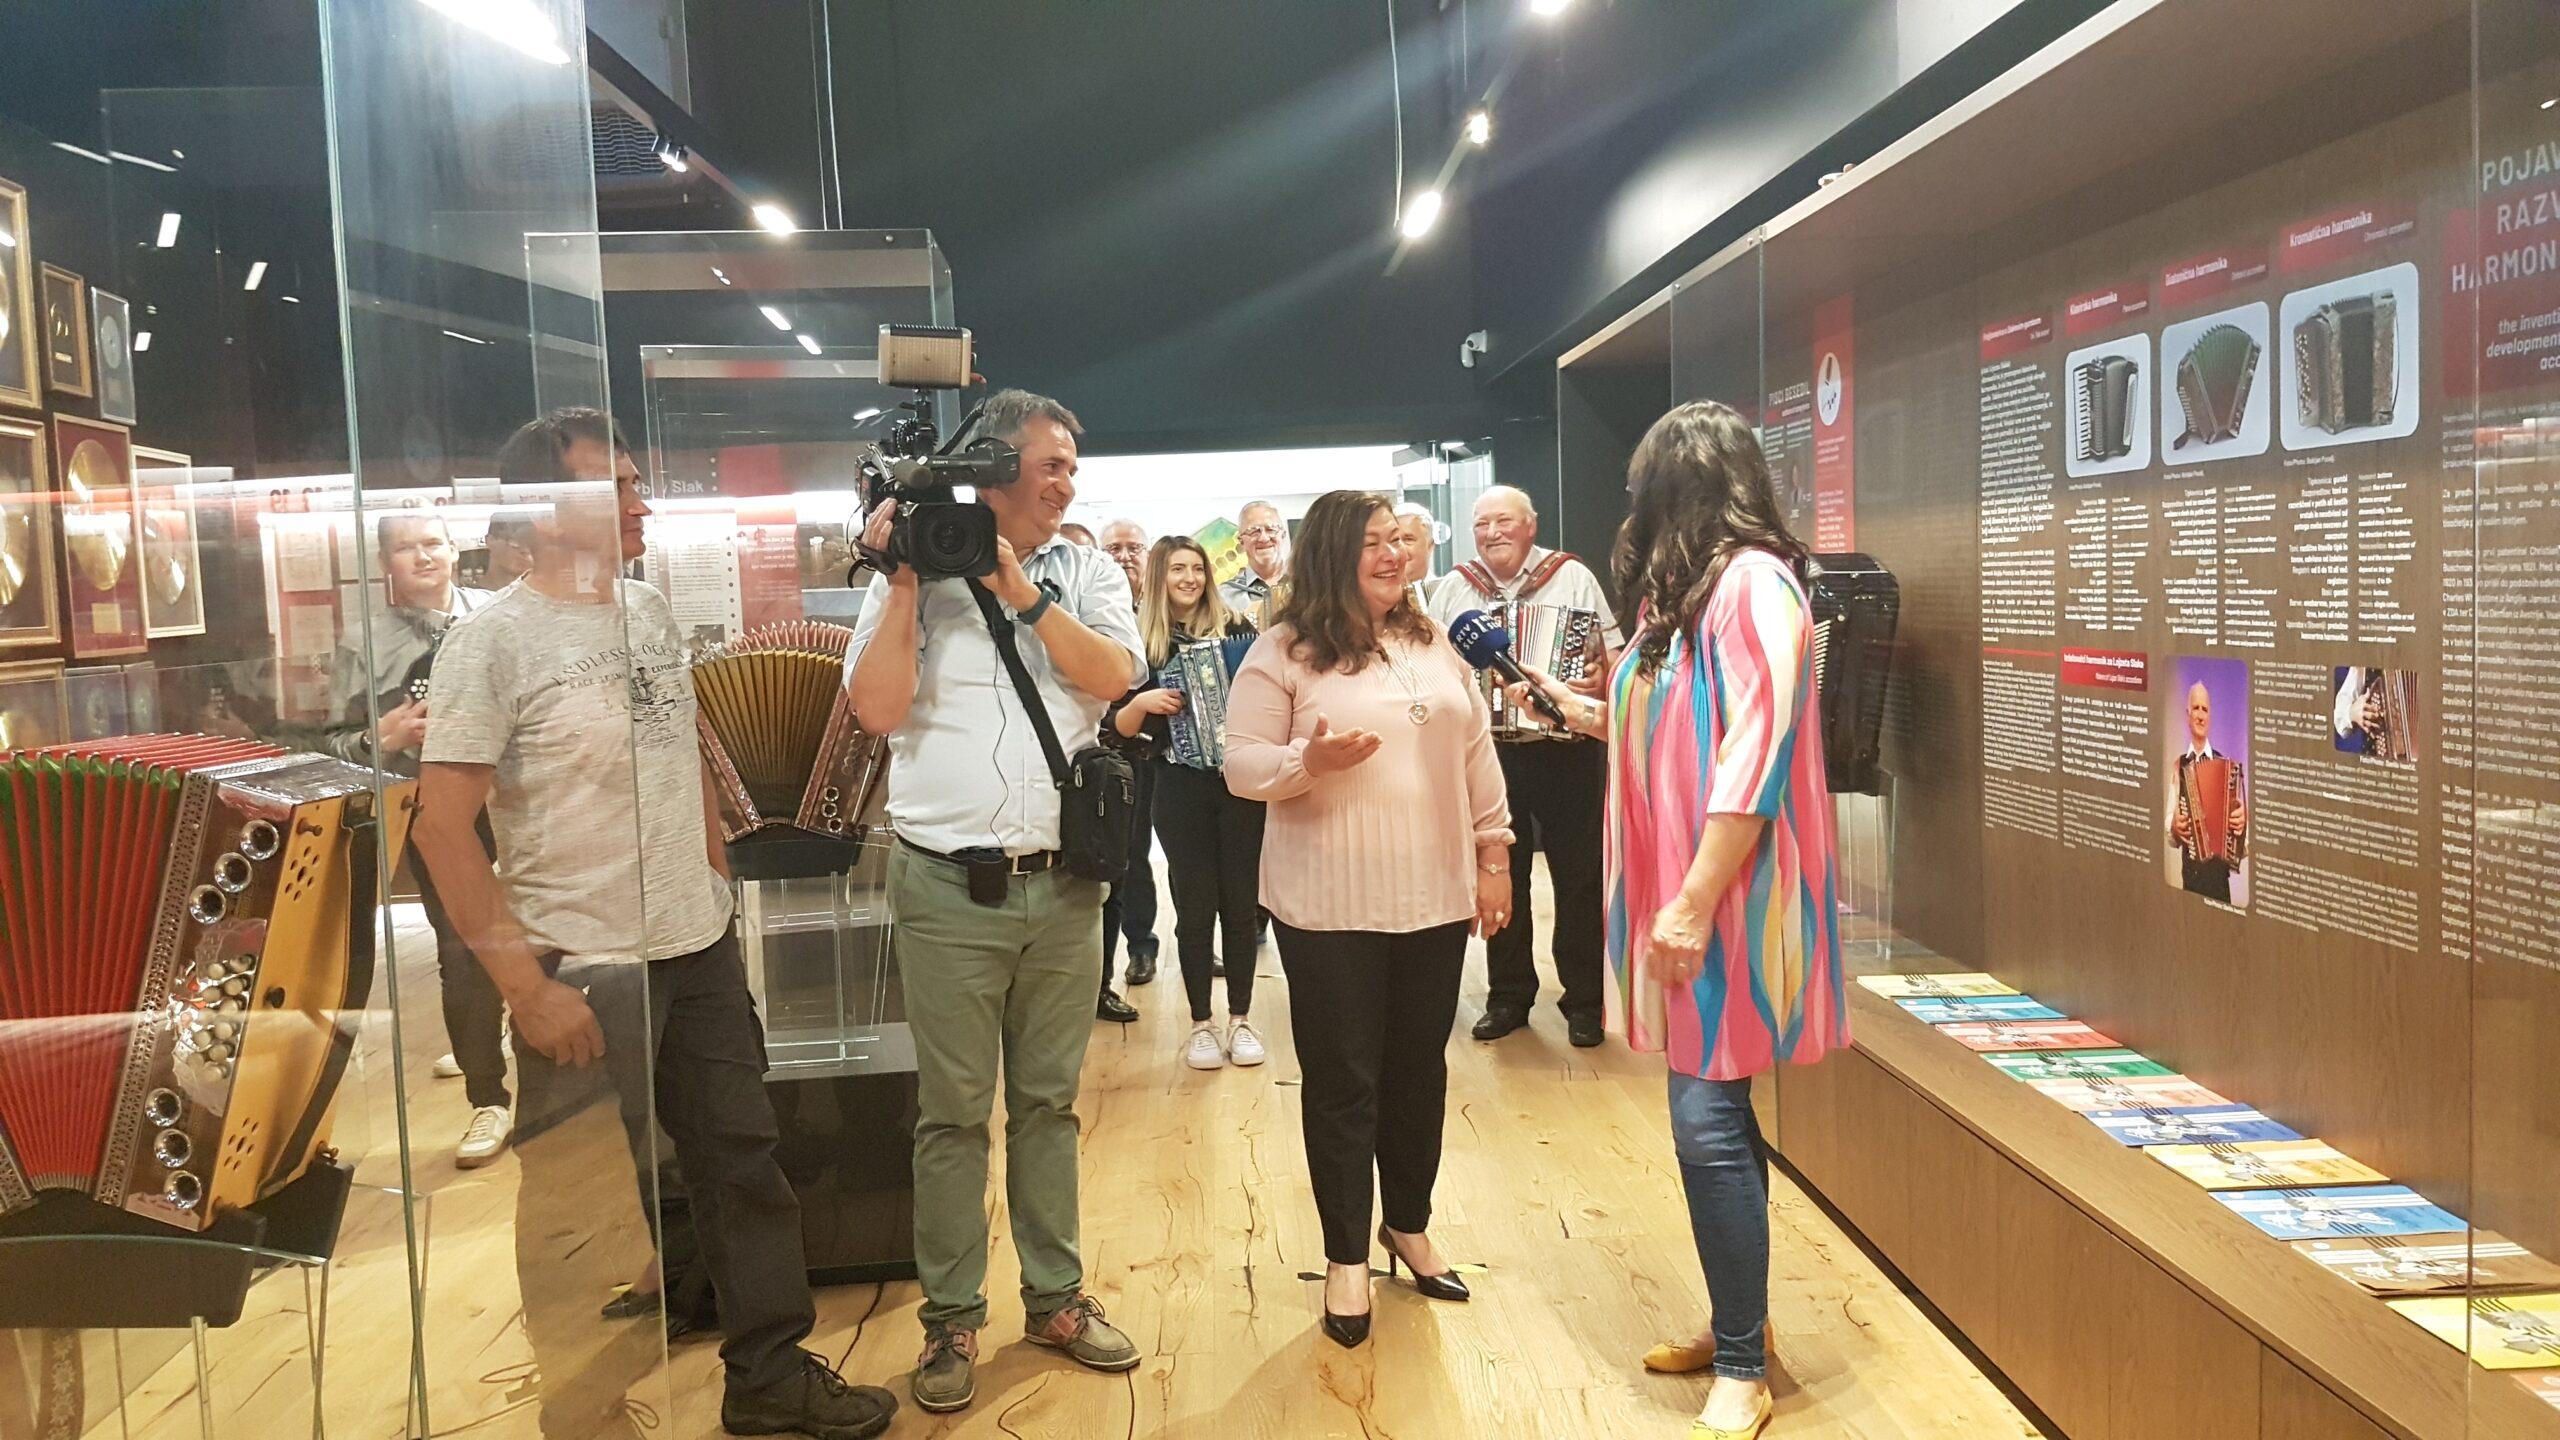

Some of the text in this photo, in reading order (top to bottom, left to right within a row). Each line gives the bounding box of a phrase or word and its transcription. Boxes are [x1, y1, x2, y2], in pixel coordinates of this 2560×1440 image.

[672, 481, 704, 494] Slak
[1456, 623, 1471, 643] RTV
[1463, 631, 1479, 650] SLO
